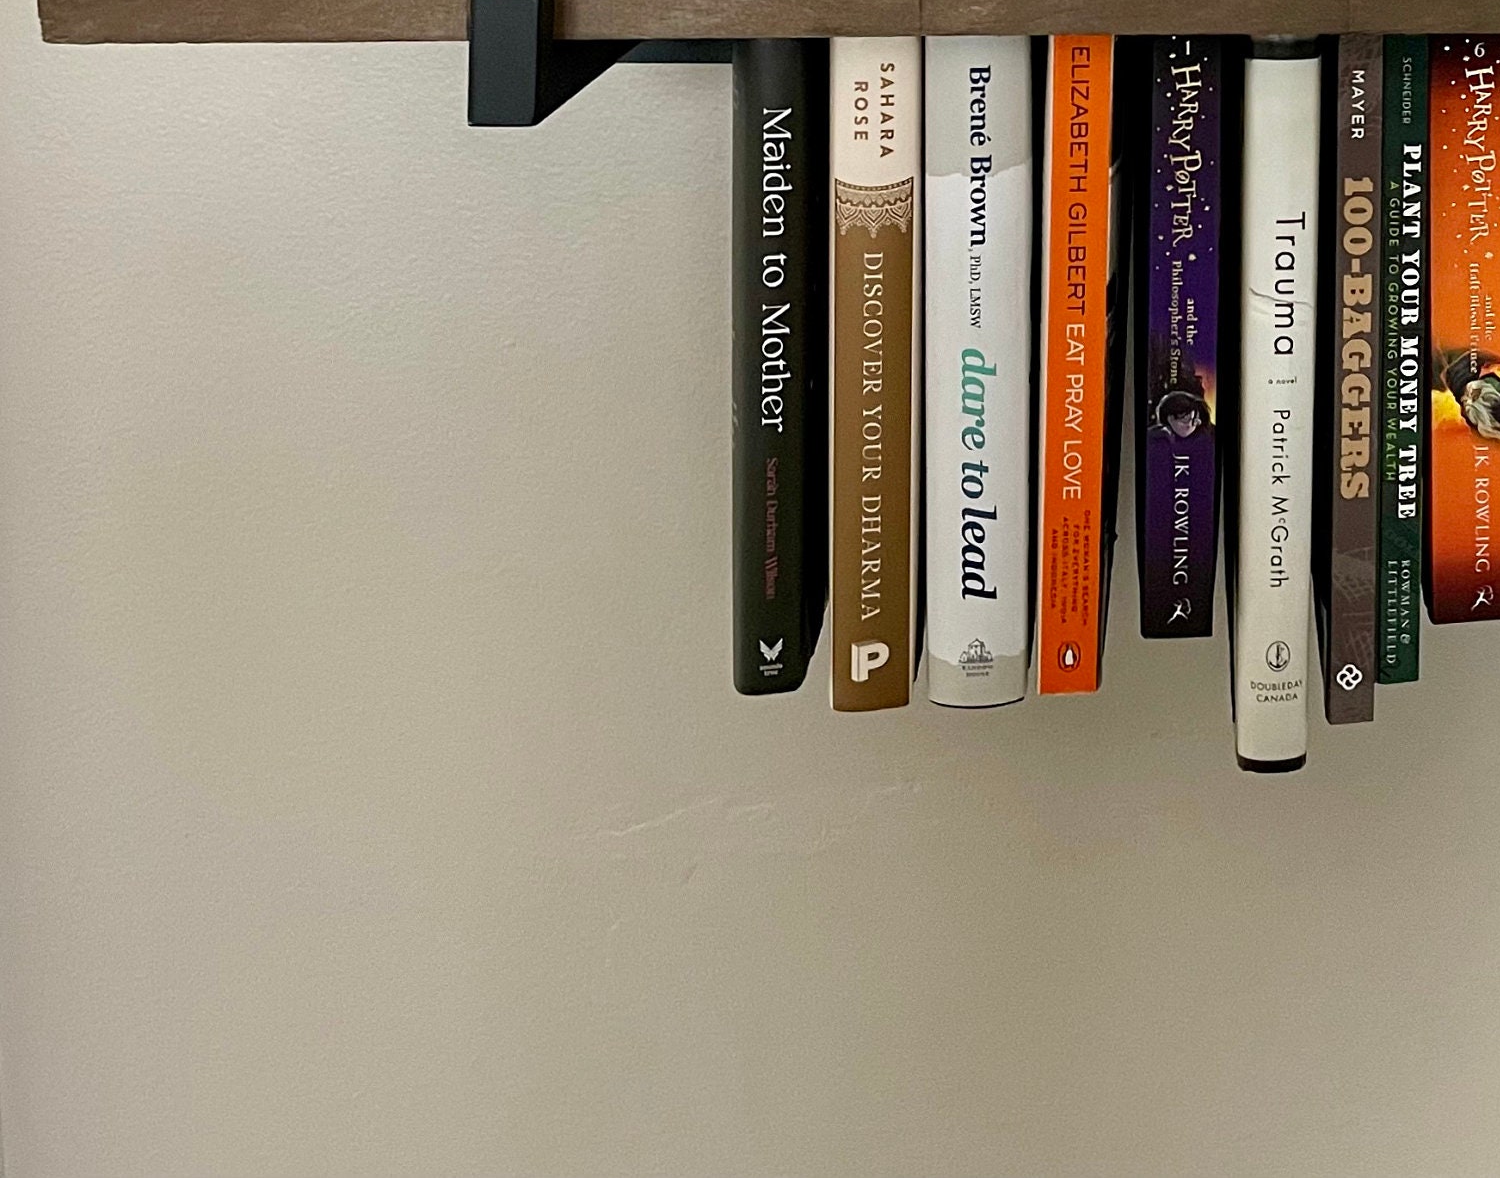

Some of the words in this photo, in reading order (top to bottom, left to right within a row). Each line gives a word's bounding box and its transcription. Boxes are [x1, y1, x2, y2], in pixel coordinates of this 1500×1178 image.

[1474, 41, 1485, 58] 6
[854, 81, 869, 141] ROSE
[879, 62, 895, 158] SAHARA
[969, 65, 991, 146] Brené
[1069, 46, 1091, 193] ELIZABETH
[1167, 63, 1203, 151] HARRY
[1350, 69, 1365, 140] MAYER
[1401, 56, 1412, 124] SCHNEIDER
[1463, 65, 1496, 153] HARRY
[762, 108, 793, 237] Maiden
[968, 154, 992, 252] Brown,
[1169, 149, 1203, 247] POTTER
[1389, 180, 1399, 190] A
[1402, 143, 1423, 239] PLANT
[1465, 150, 1497, 245] POTTER
[1066, 202, 1088, 316] GILBERT
[1388, 197, 1400, 247] GUIDE
[762, 253, 788, 288] to
[968, 255, 981, 284] PhD,
[1168, 260, 1183, 346] Philosopher's
[1274, 211, 1306, 356] Trauma
[1388, 255, 1399, 275] TO
[1400, 248, 1421, 325] YOUR
[862, 252, 883, 395] DISCOVER
[969, 288, 981, 329] LMSW
[1186, 298, 1197, 321] and
[1186, 324, 1197, 345] the
[1339, 176, 1374, 500] 100-BAGGERS
[1387, 282, 1399, 360] GROWING
[1484, 294, 1496, 317] and
[1484, 321, 1496, 341] the
[761, 302, 792, 433] Mother
[1065, 323, 1085, 366] EAT
[1169, 348, 1181, 384] Stone
[1276, 376, 1298, 385] novel
[961, 348, 997, 451] dare
[1064, 374, 1084, 433] PRAY
[1385, 368, 1398, 410] YOUR
[1399, 335, 1420, 434] MONEY
[766, 458, 779, 496] Sarah
[862, 404, 882, 482] YOUR
[961, 460, 989, 499] to
[1062, 440, 1082, 500] LOVE
[1270, 409, 1291, 485] Patrick
[1385, 417, 1397, 482] WEALTH
[1397, 444, 1418, 520] TREE
[860, 495, 881, 621] DHARMA
[961, 505, 997, 600] lead
[1172, 487, 1190, 586] ROWLING
[1269, 495, 1289, 589] McGrath
[1473, 477, 1491, 573] ROWLING
[764, 555, 778, 600] Wilson
[1385, 560, 1398, 664] LITTLEFIELD
[1400, 559, 1411, 628] ROWMAN
[1256, 693, 1298, 703] CANADA
